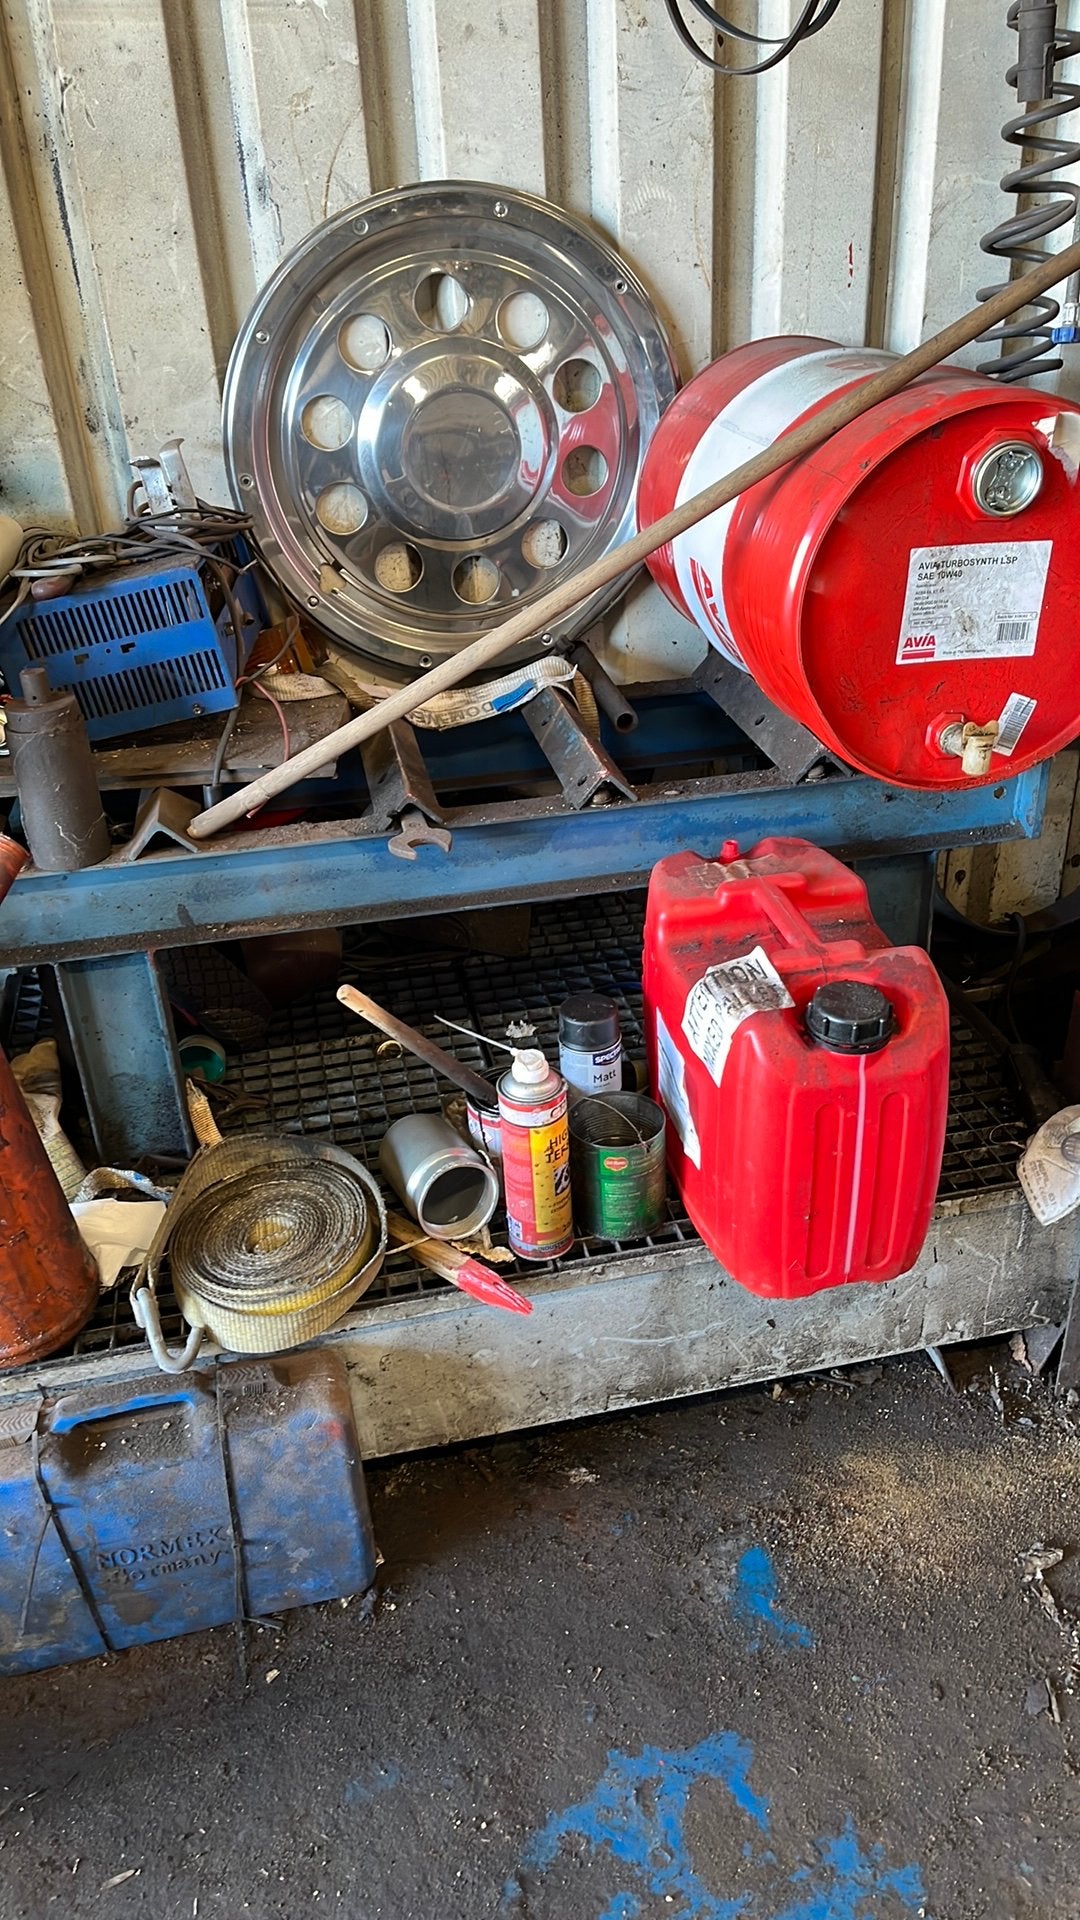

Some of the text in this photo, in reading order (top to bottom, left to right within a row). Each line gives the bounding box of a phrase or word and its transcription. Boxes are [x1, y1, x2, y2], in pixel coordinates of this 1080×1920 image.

[918, 556, 1018, 570] AVIA TURBOSYNTH LSP
[917, 570, 963, 581] SAE 10W40
[903, 634, 937, 649] AVIA
[687, 958, 769, 1045] ATTENTION
[593, 1069, 617, 1084] Matt
